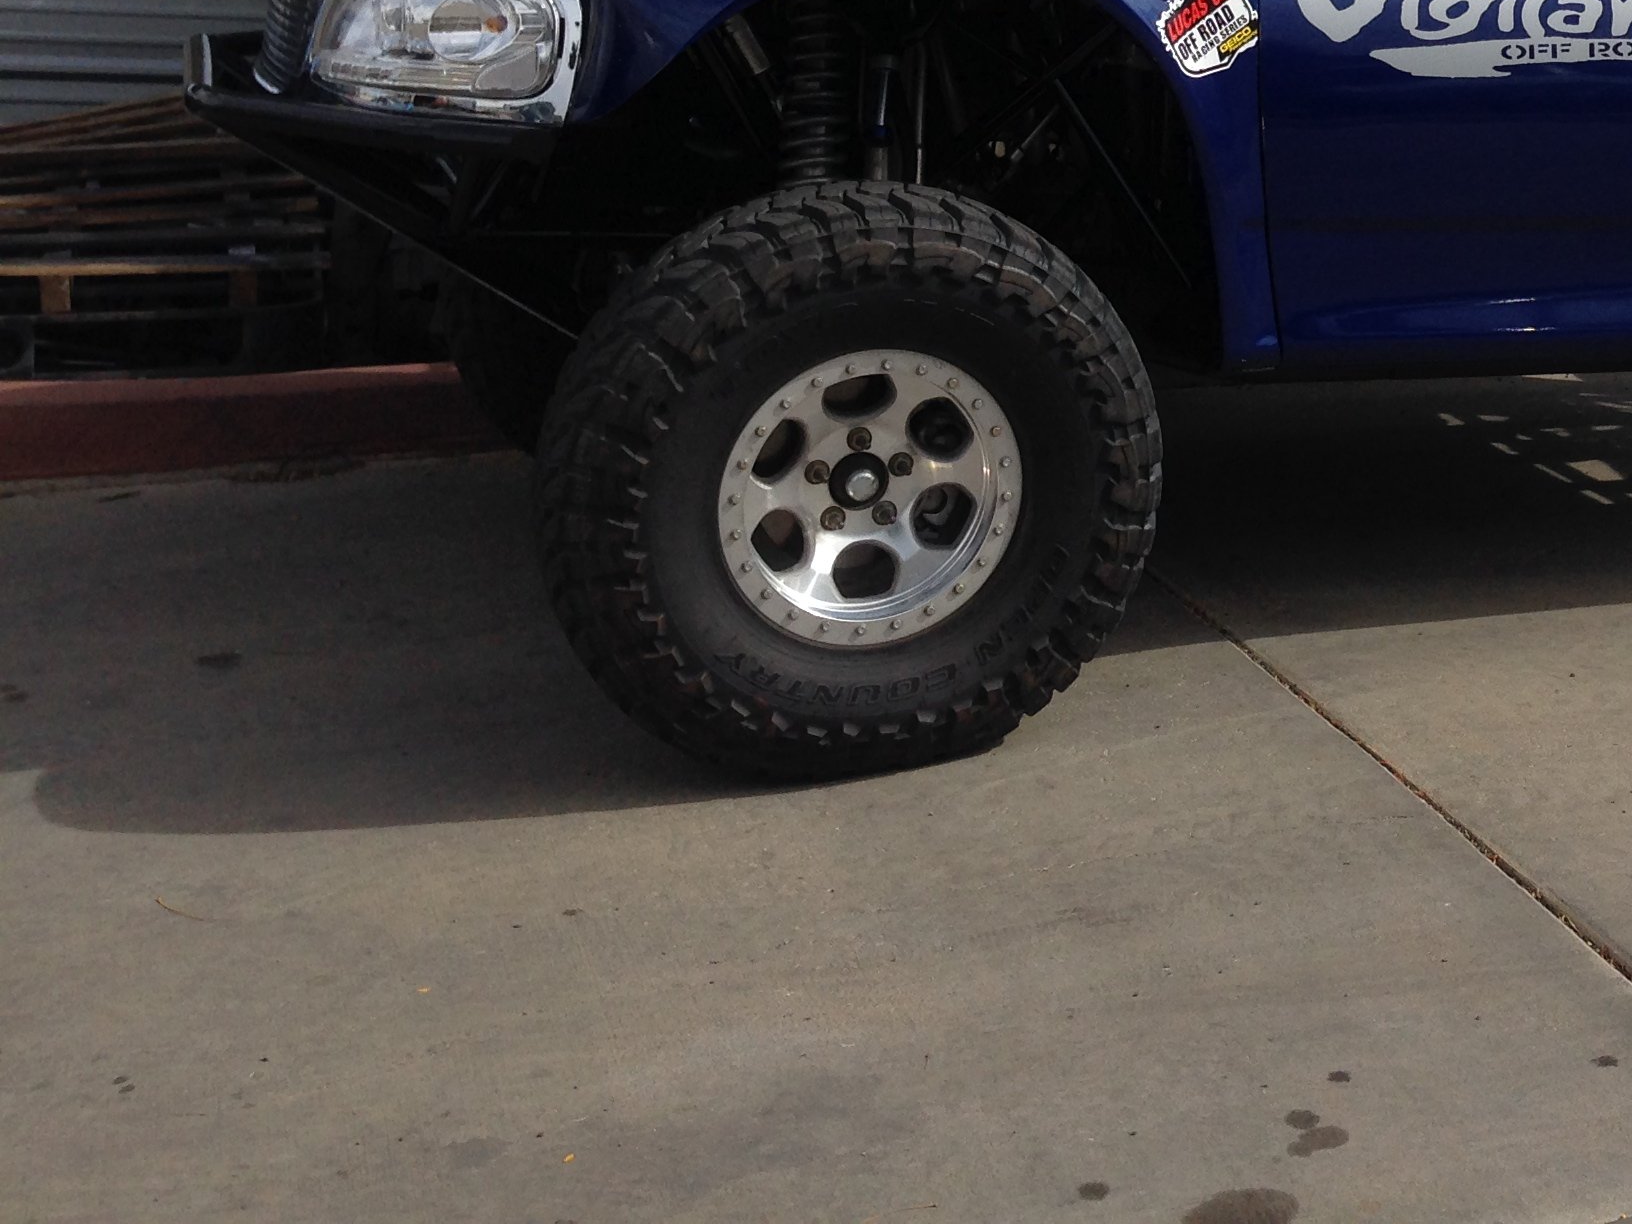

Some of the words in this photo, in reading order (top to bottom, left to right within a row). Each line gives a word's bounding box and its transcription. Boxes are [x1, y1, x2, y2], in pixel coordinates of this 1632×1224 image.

[1178, 32, 1198, 60] OFF
[1197, 4, 1235, 42] ROAD
[1191, 36, 1221, 63] RACING
[1220, 15, 1248, 40] SERIES
[1220, 26, 1252, 53] GEICO
[1501, 42, 1572, 60] OFF
[712, 649, 960, 707] COUNTRY
